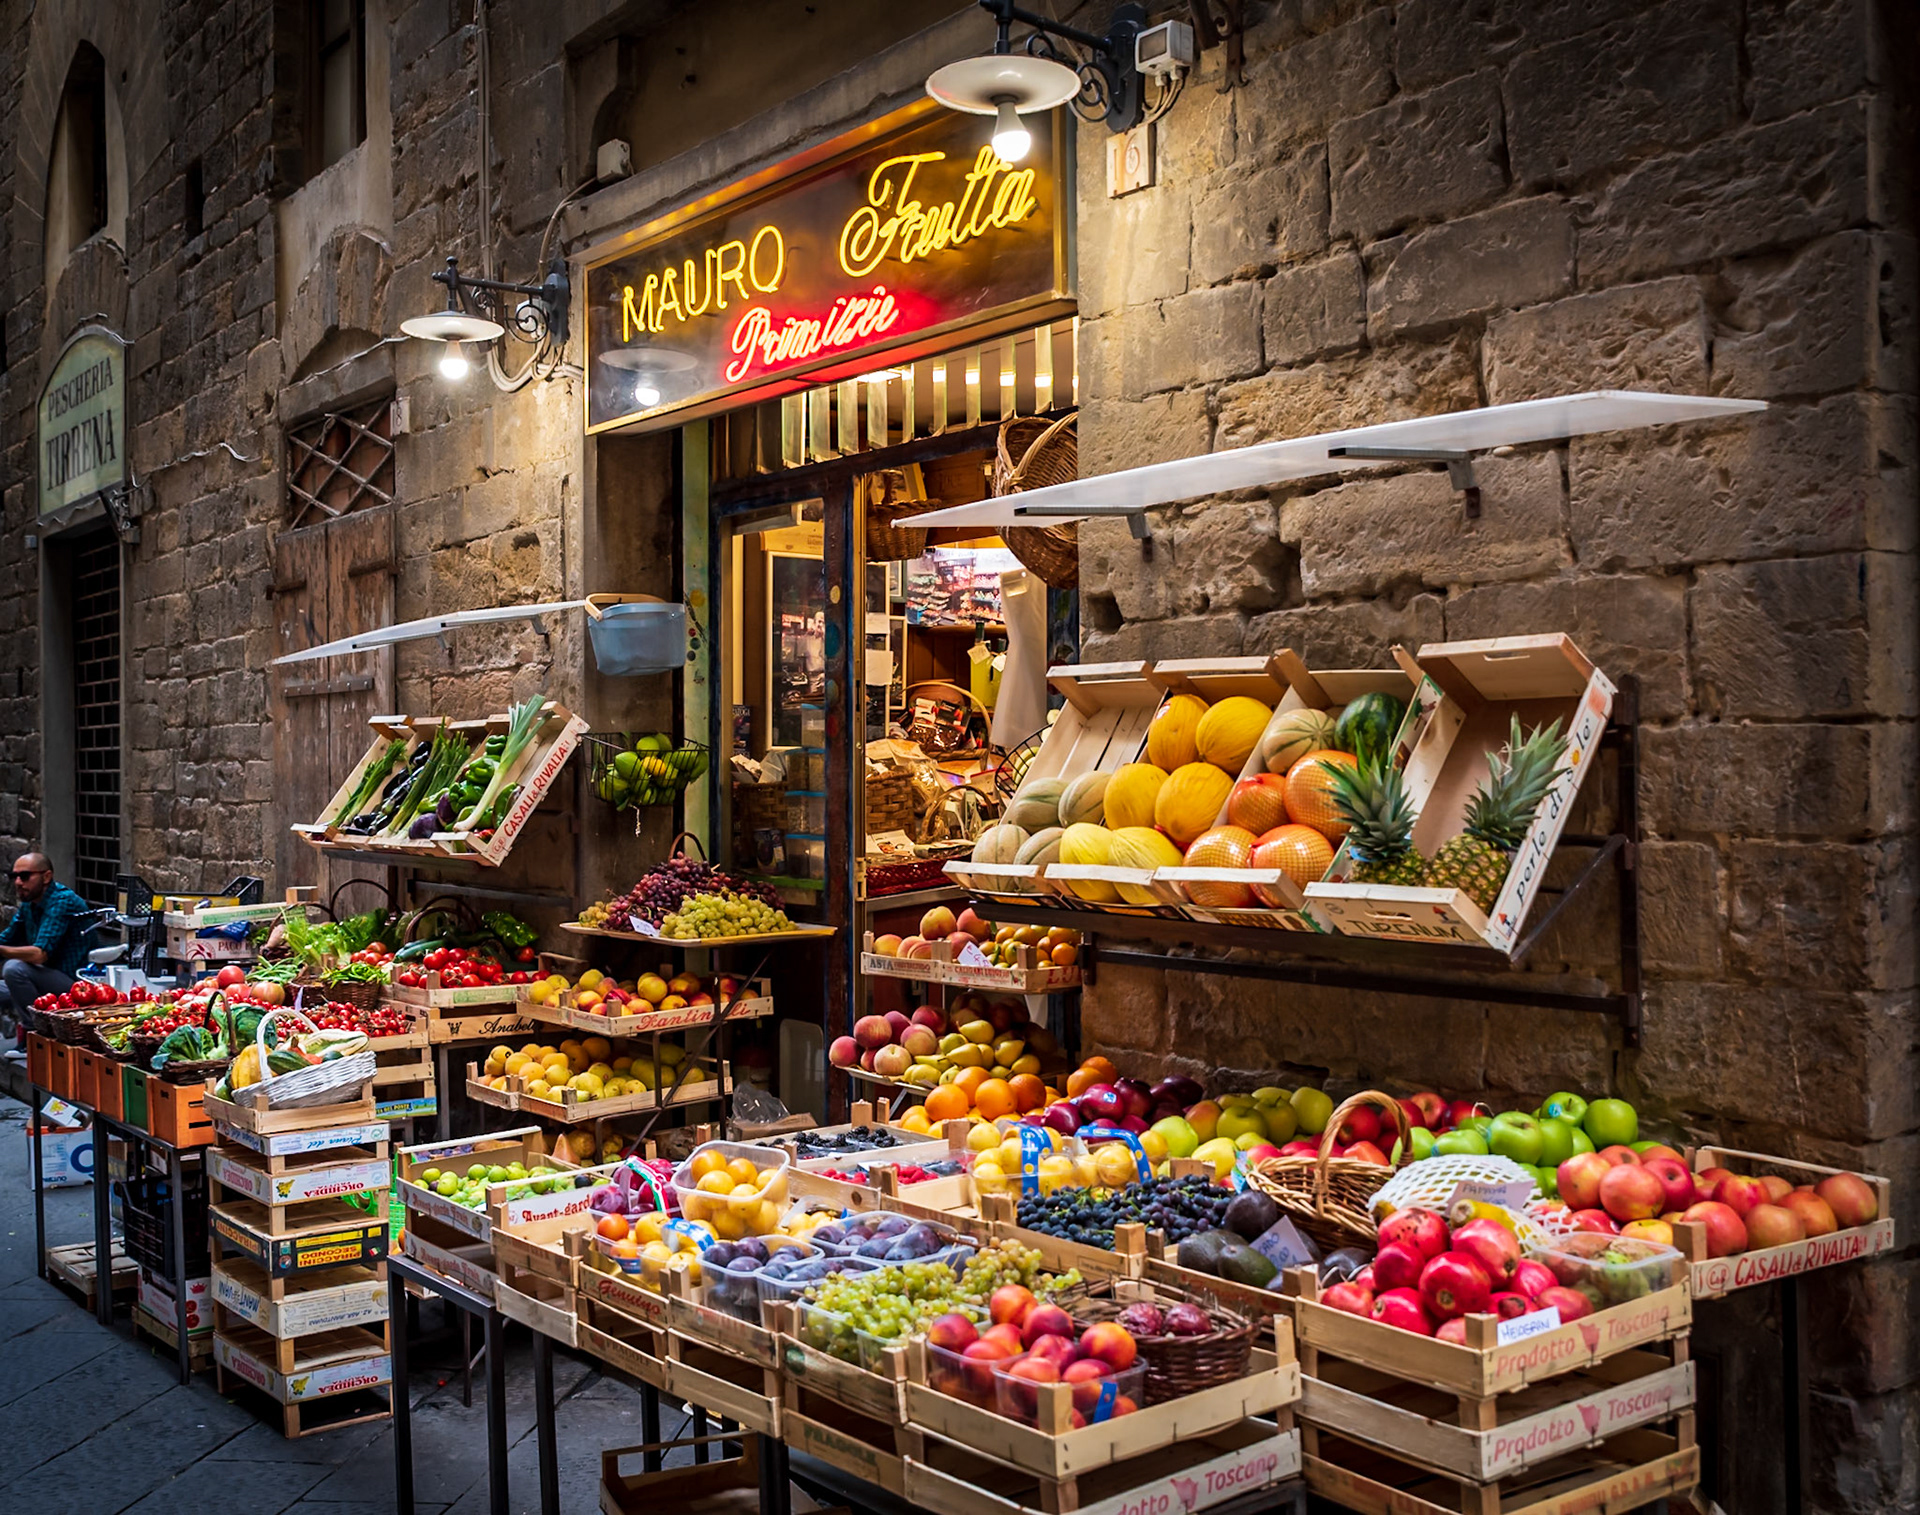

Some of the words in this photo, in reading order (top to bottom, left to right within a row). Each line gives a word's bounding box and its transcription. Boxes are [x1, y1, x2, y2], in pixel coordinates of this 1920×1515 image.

[622, 224, 785, 343] MAURO
[47, 356, 114, 422] PESCHERIA
[46, 408, 117, 491] TIRRENA
[503, 793, 536, 838] CASALI
[532, 745, 569, 792] RIVALTA
[1515, 829, 1548, 905] perle
[1550, 788, 1565, 821] di
[1345, 919, 1466, 941] TURENUM
[303, 1181, 365, 1199] ORCHIDEA
[521, 1193, 592, 1223] Avant-gard
[298, 1250, 362, 1268] PIRACCINI
[301, 1245, 358, 1259] SECONDO
[1734, 1250, 1794, 1286] CASALI
[1803, 1235, 1861, 1272] RIVALTA
[598, 1278, 662, 1316] Genuino
[1494, 1336, 1576, 1379] Prodotto
[1606, 1305, 1670, 1341] Toscano
[318, 1374, 379, 1394] ORCHIDEA
[1493, 1418, 1575, 1462] Prodotto
[1607, 1384, 1673, 1421] Toscano
[1204, 1452, 1279, 1495] Toscano
